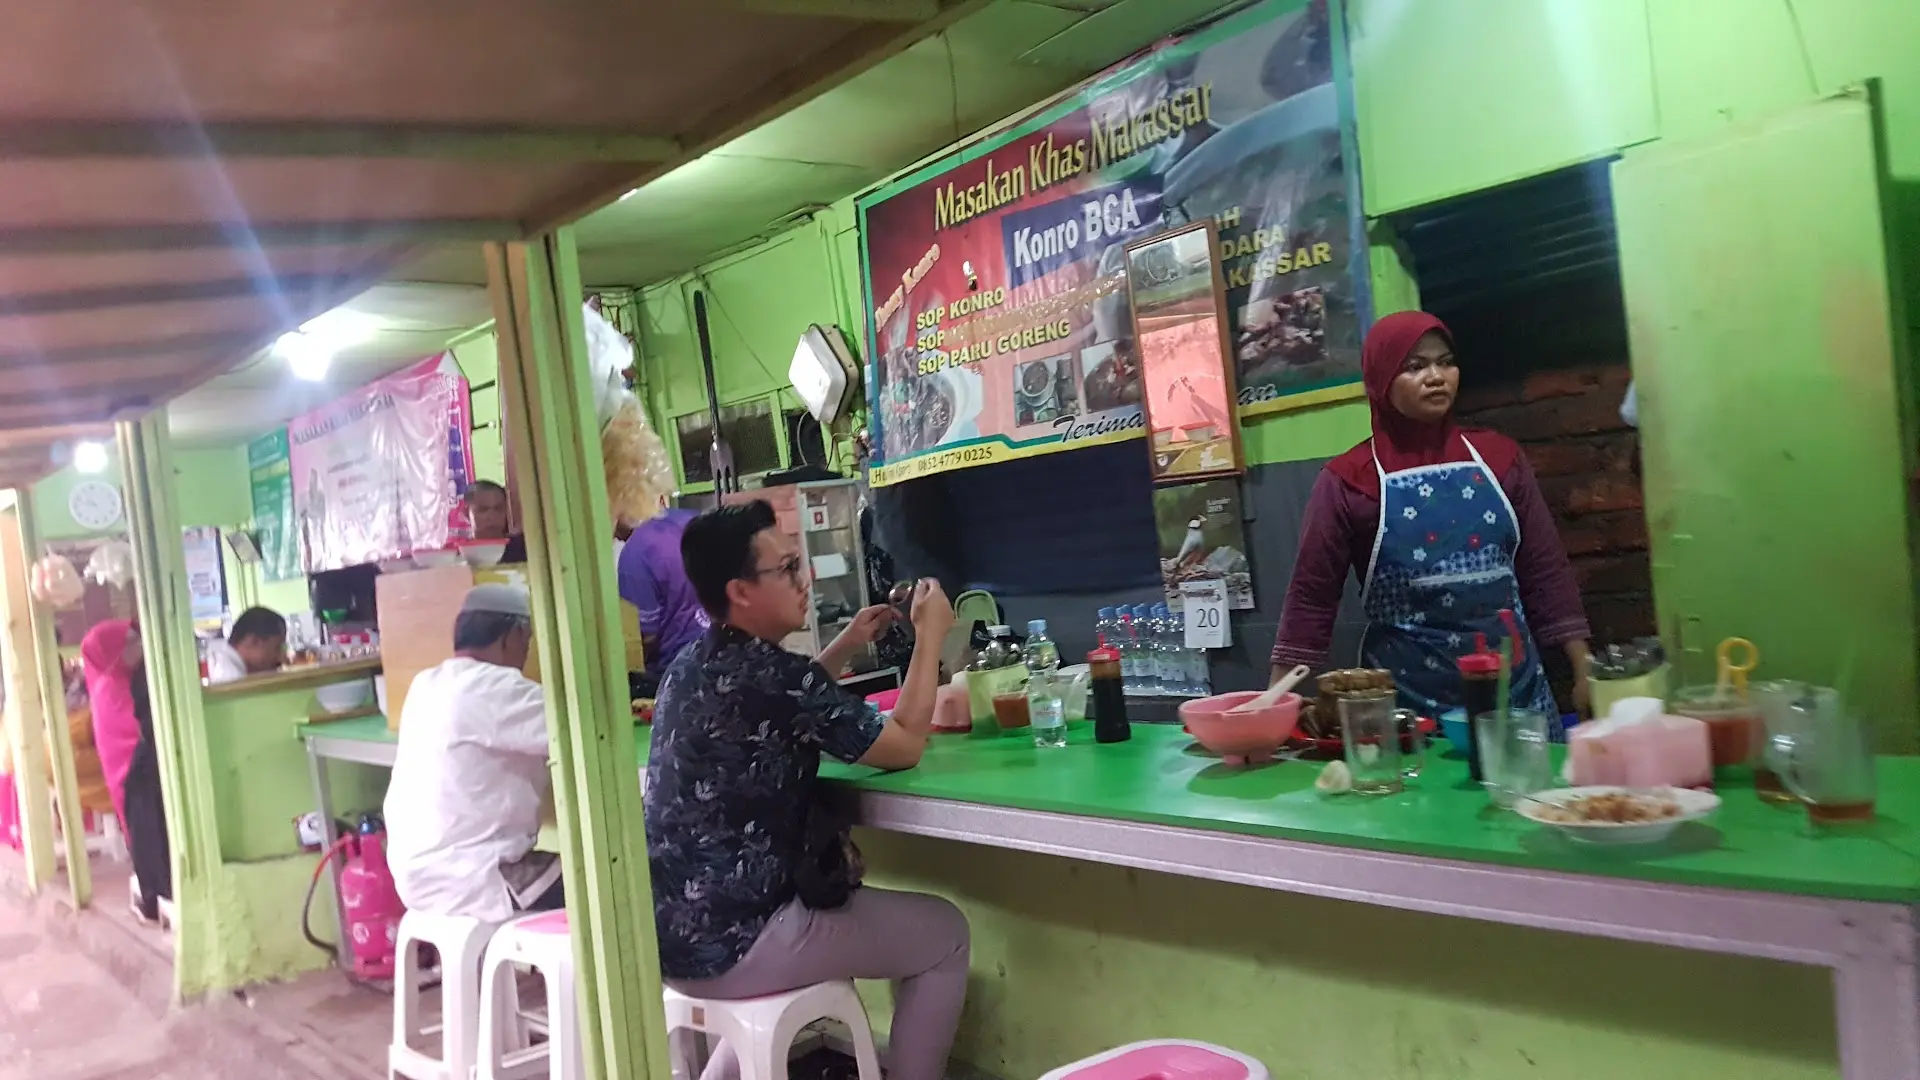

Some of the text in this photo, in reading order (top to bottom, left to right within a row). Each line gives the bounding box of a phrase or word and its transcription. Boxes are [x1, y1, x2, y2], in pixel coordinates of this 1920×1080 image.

[934, 79, 1213, 230] Masakan Khas Makassar
[1013, 187, 1142, 268] Konro BCA
[1219, 224, 1286, 261] DARA
[1226, 242, 1333, 289] KASSAR
[916, 307, 946, 331] SOP
[949, 286, 1005, 320] KONRO
[916, 330, 946, 354] SOP
[917, 354, 946, 377] SOP
[949, 340, 994, 369] PARU
[996, 318, 1072, 352] GORENG
[1053, 414, 1146, 443] Terima
[1196, 607, 1221, 629] 20
